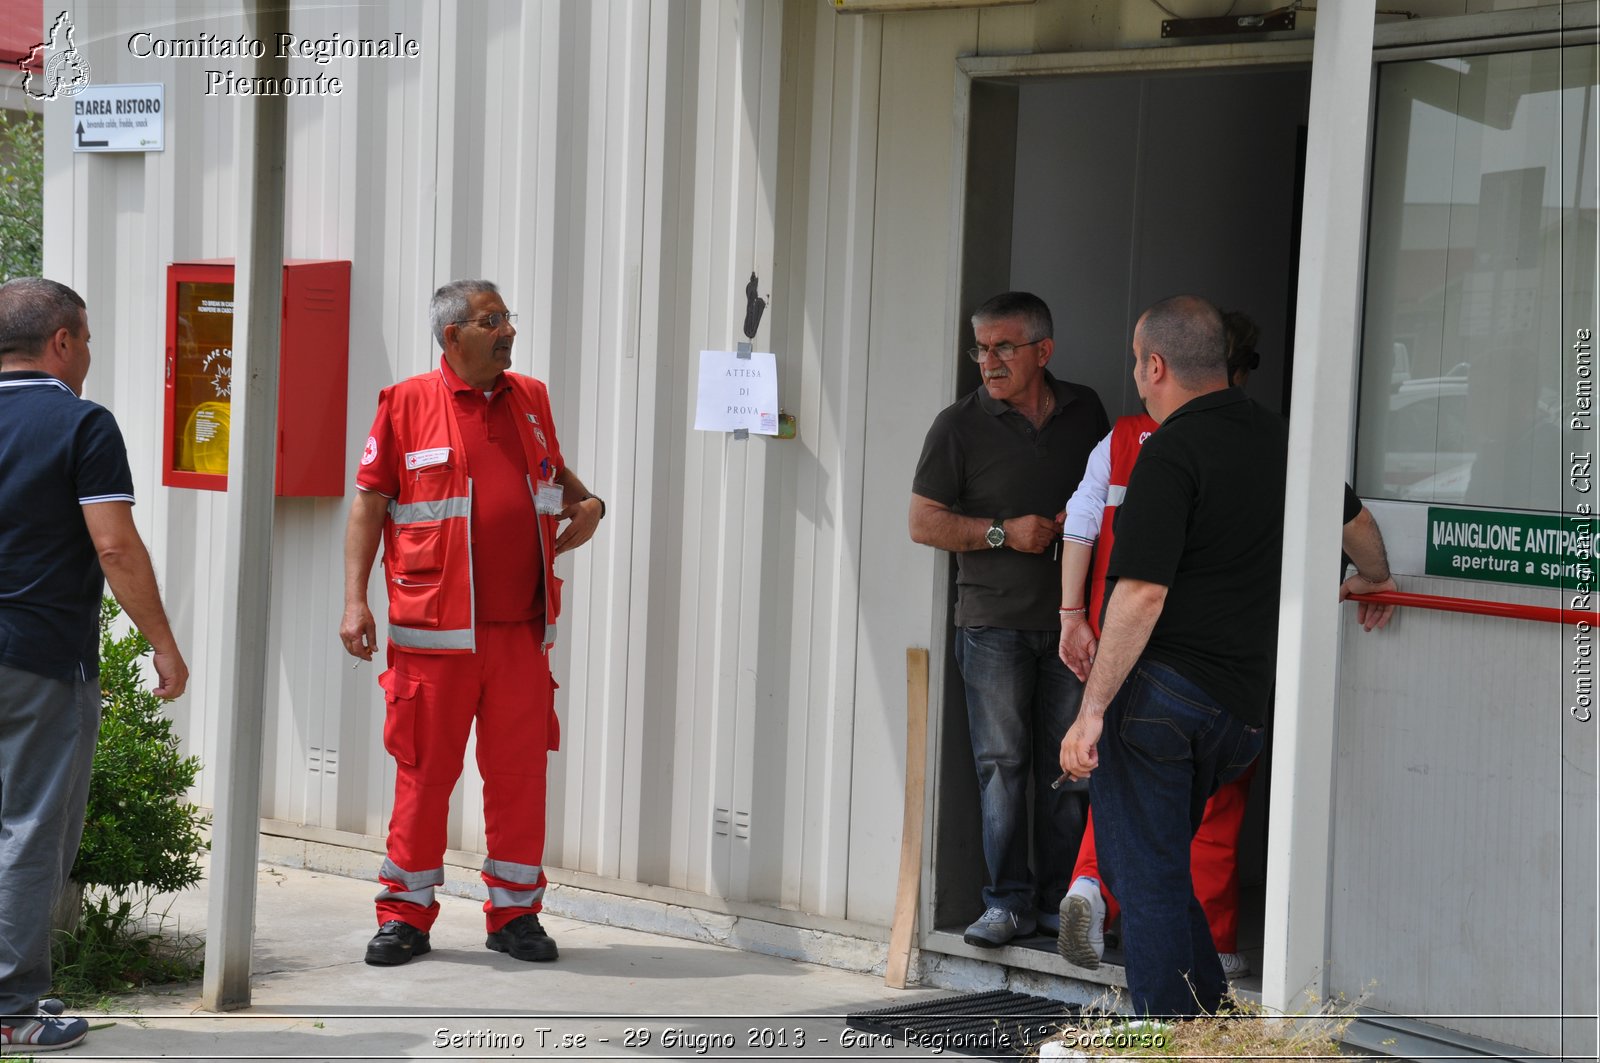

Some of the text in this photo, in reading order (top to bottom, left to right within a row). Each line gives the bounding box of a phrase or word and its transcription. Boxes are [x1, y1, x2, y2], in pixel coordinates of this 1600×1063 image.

[85, 98, 161, 115] AREA RISTORO
[725, 369, 761, 378] ATTESA
[739, 387, 750, 396] DI
[727, 406, 759, 415] PROVA
[1432, 520, 1522, 551] MANIGLIONE
[1452, 554, 1519, 572] apertura
[1525, 561, 1535, 574] a
